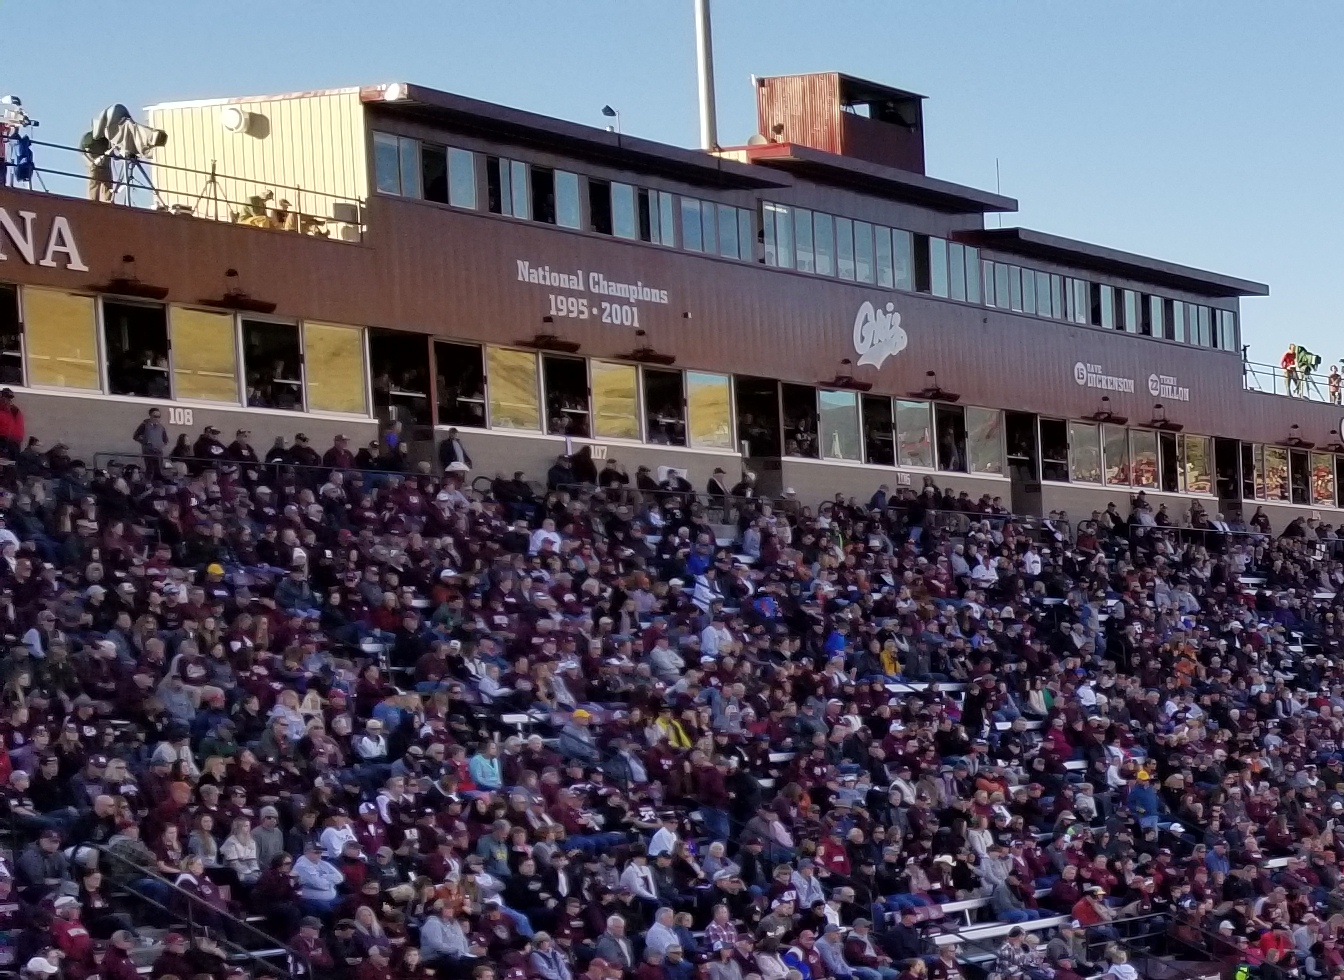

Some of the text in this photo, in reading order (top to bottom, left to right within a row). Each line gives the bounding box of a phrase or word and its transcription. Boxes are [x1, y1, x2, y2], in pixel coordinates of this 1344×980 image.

[517, 260, 669, 303] National Champions
[549, 294, 639, 328] 1995 2001
[1088, 373, 1134, 393] DICKENSON
[1161, 385, 1189, 401] DILLON
[169, 407, 193, 425] 108
[590, 445, 607, 459] 107
